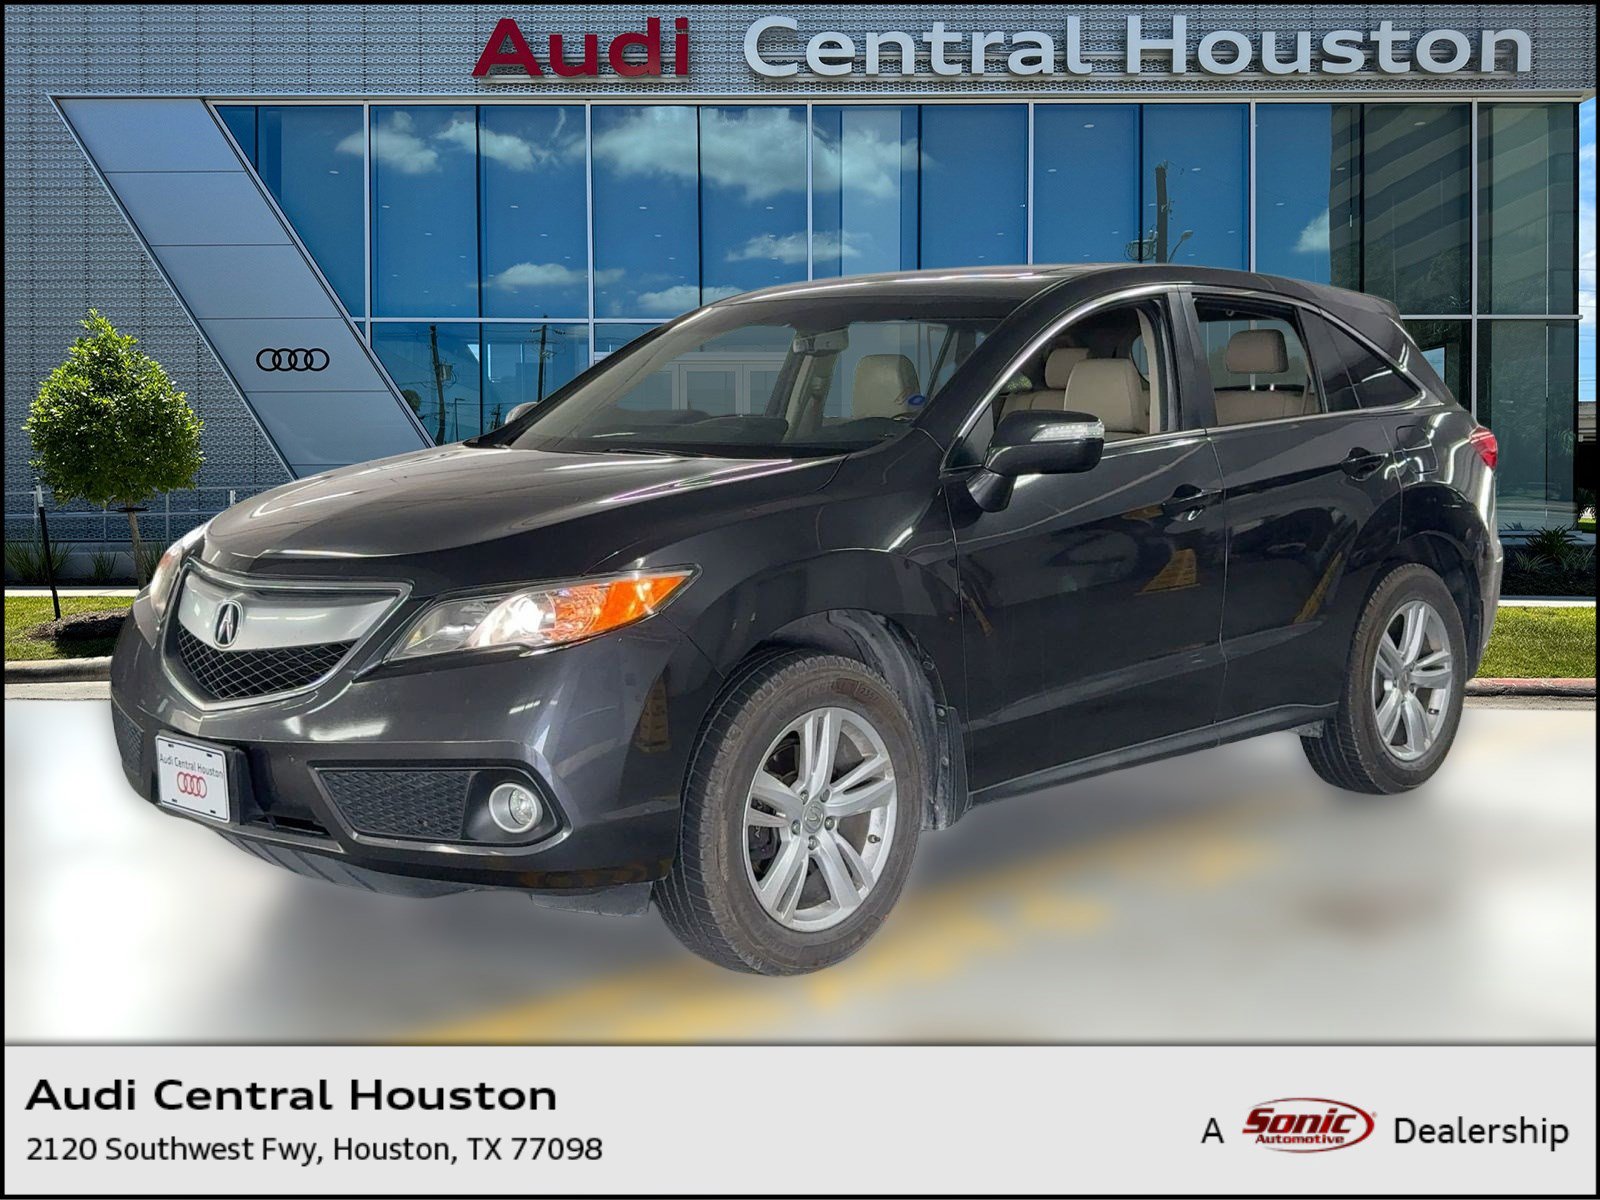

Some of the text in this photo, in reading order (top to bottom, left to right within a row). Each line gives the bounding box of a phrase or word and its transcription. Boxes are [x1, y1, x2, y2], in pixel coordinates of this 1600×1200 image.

[472, 15, 1532, 78] Audi Central Houston
[160, 753, 224, 778] Audi Central Houston
